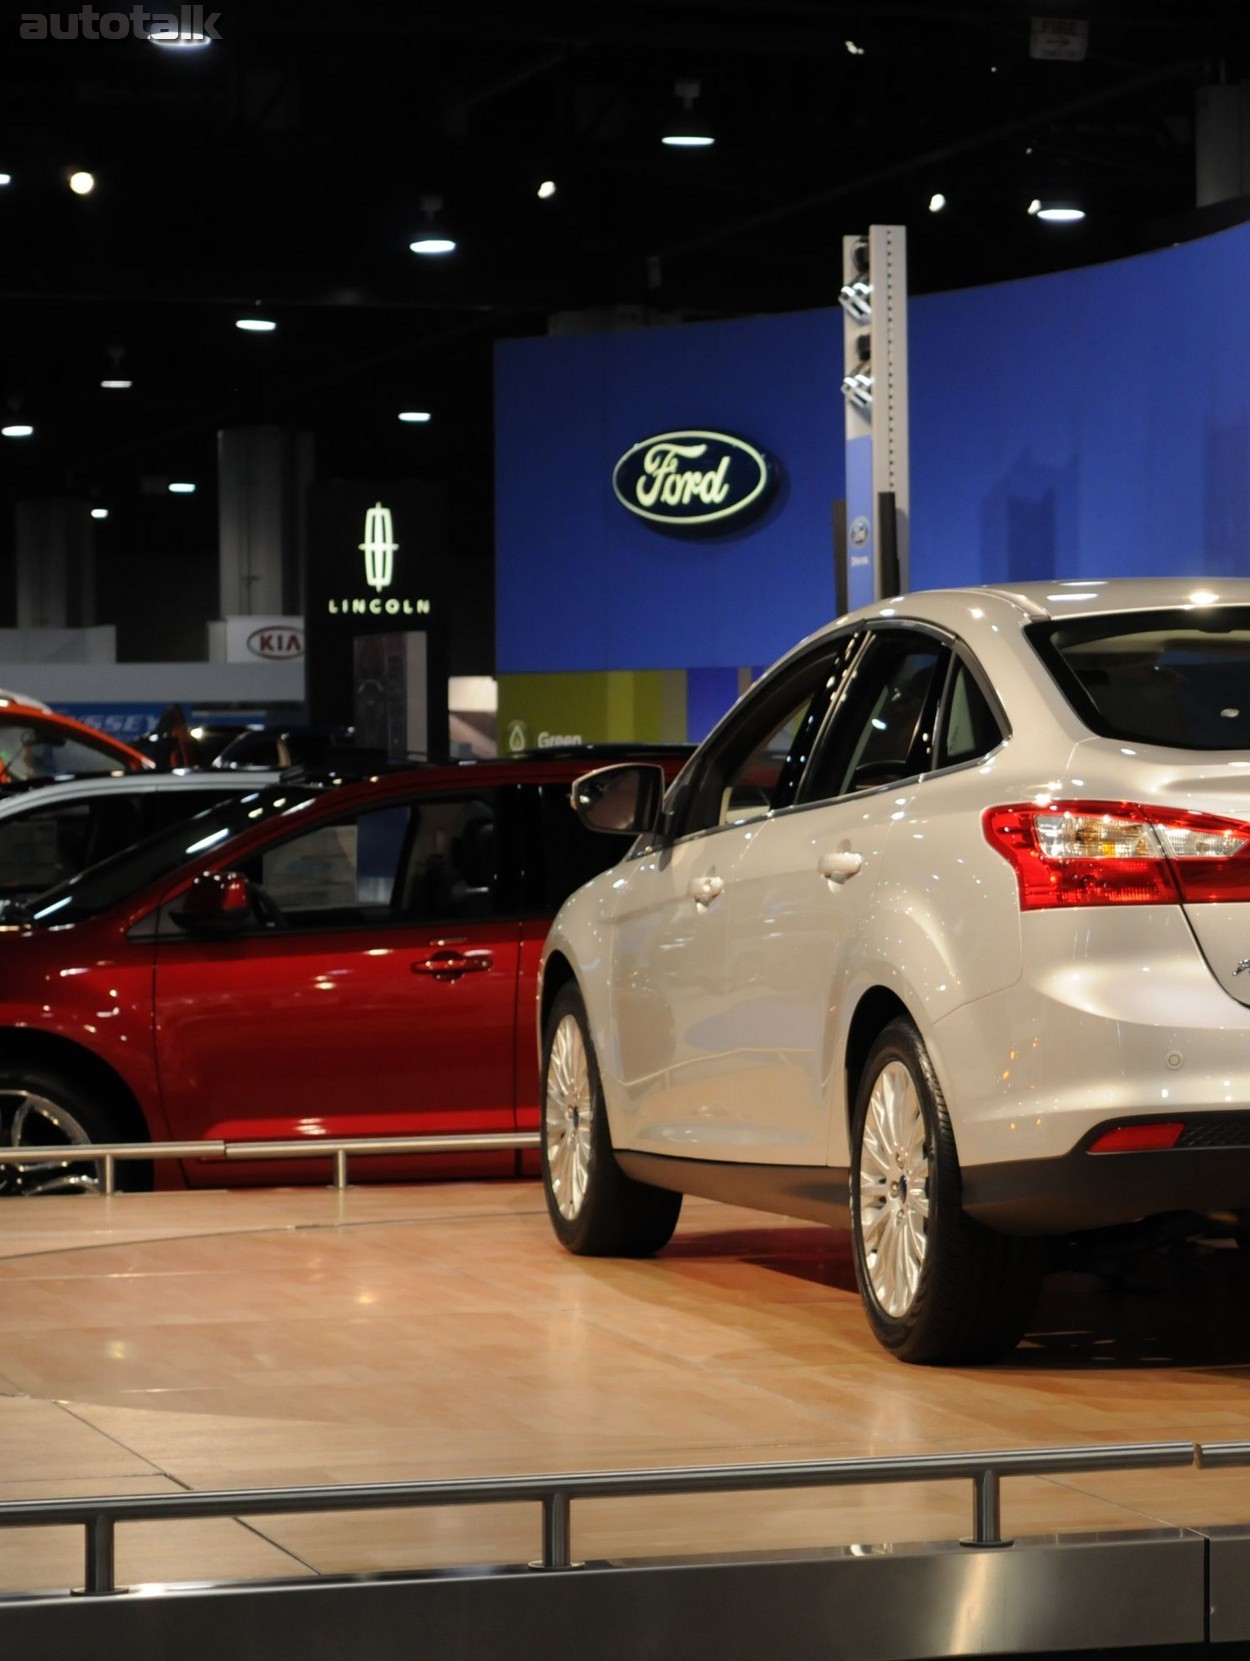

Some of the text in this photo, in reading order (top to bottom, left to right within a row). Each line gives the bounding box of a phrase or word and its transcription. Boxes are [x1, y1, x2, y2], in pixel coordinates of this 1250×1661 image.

[636, 443, 731, 507] Ford
[328, 598, 430, 614] LINCOLN
[260, 634, 300, 652] KIA
[537, 731, 582, 749] Green
